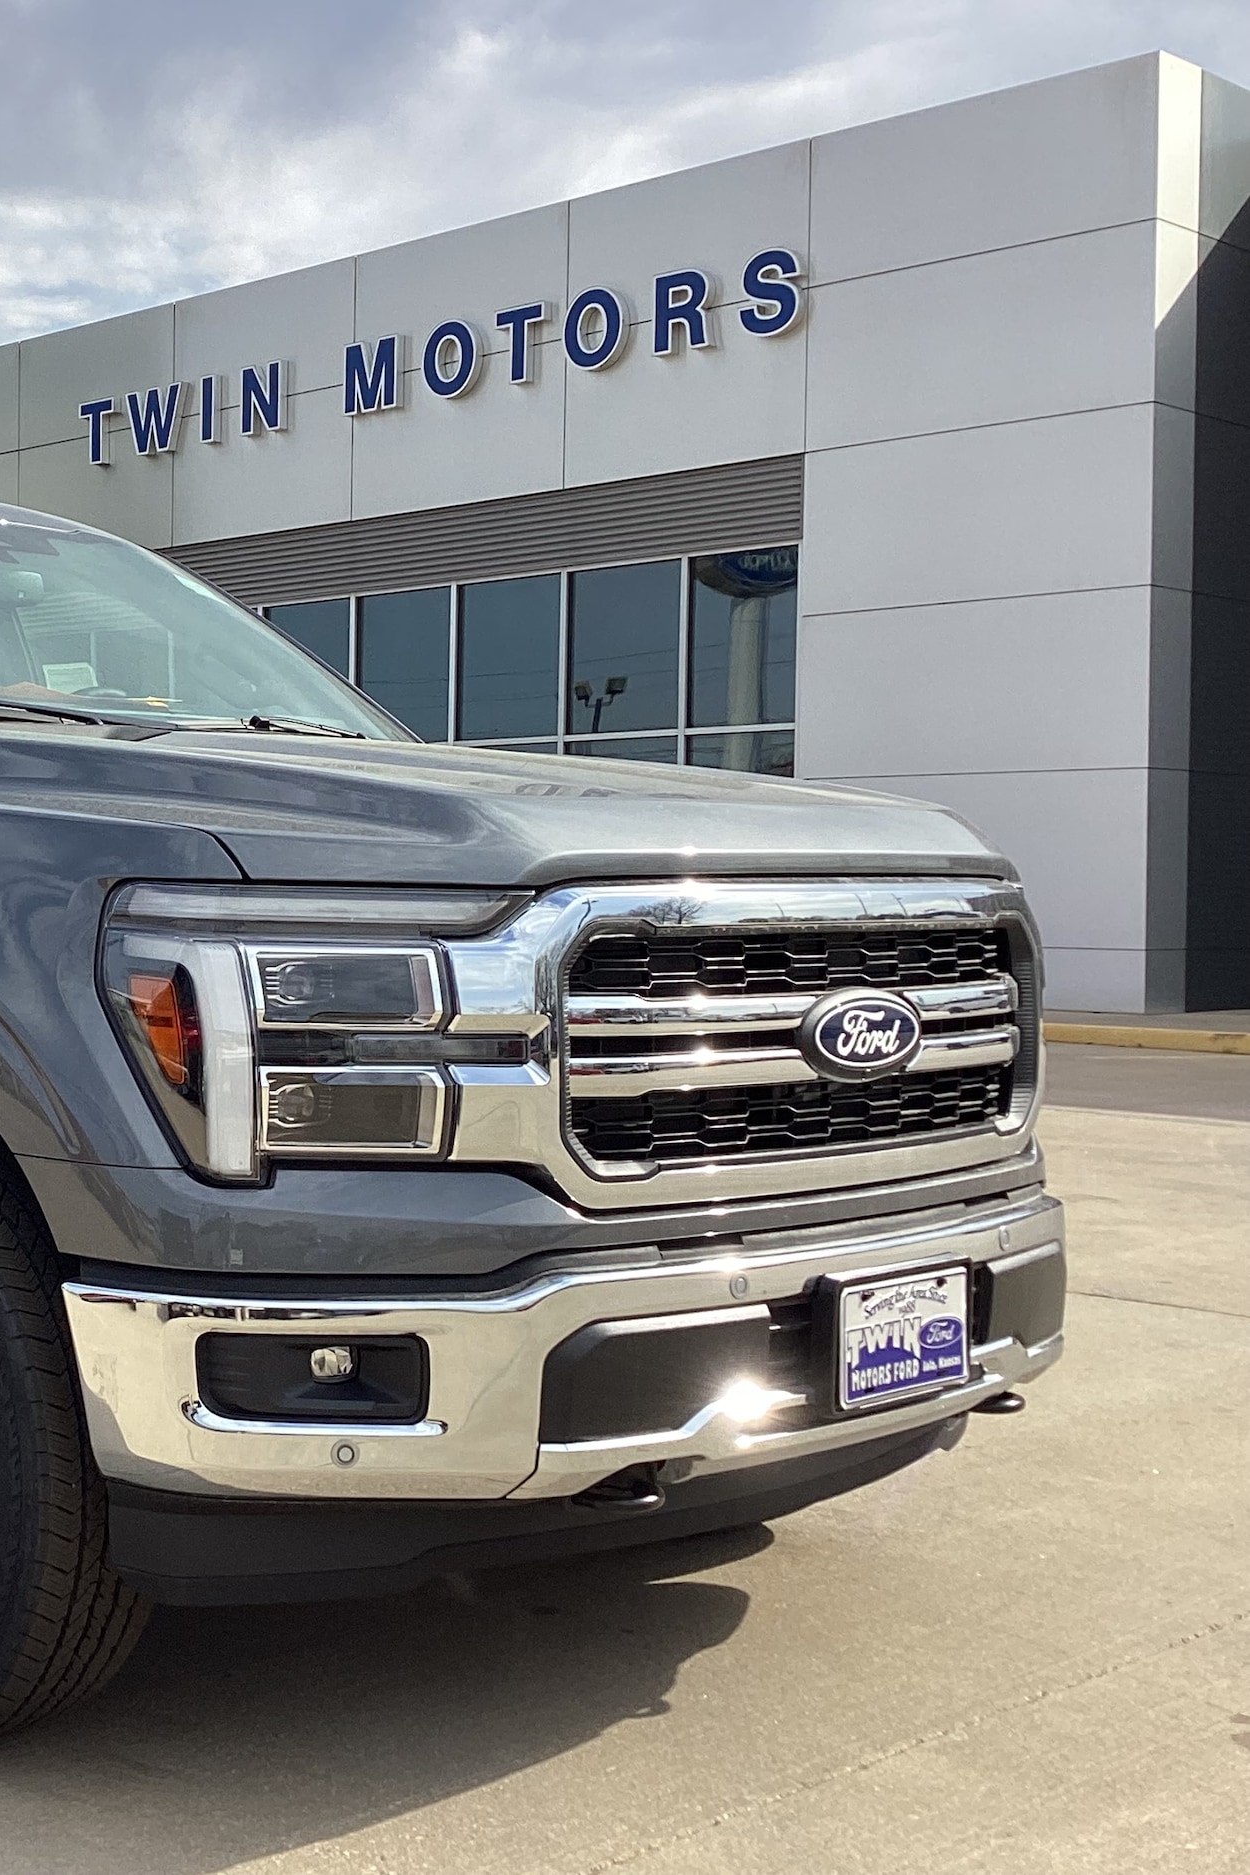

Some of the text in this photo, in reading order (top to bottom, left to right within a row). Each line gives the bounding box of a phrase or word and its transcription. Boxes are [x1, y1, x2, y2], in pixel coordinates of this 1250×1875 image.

[80, 246, 810, 465] TWIN MOTORS
[837, 1010, 901, 1056] Ford
[846, 1317, 922, 1370] TWIN
[926, 1321, 954, 1344] Ford
[852, 1363, 892, 1391] MOTORS
[894, 1359, 920, 1382] FORD
